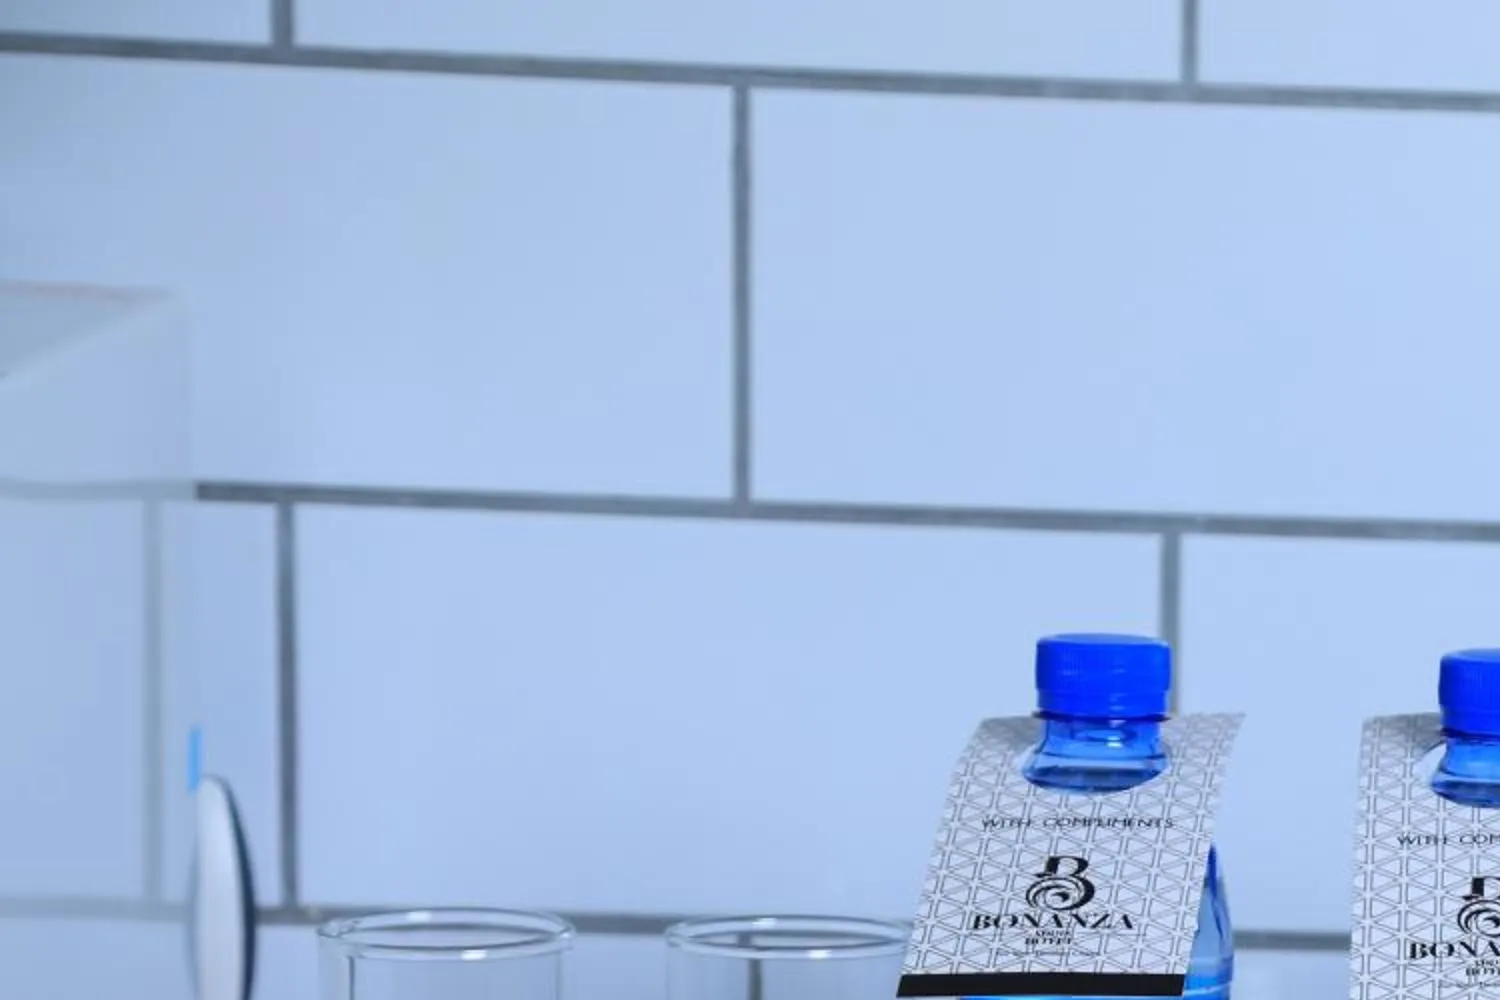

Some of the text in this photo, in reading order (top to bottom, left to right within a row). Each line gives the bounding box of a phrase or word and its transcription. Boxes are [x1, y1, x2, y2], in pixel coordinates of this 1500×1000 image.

[981, 816, 1175, 829] WITH COMPLIMENTS
[1397, 833, 1449, 846] WITH
[972, 912, 1134, 930] BONANZA
